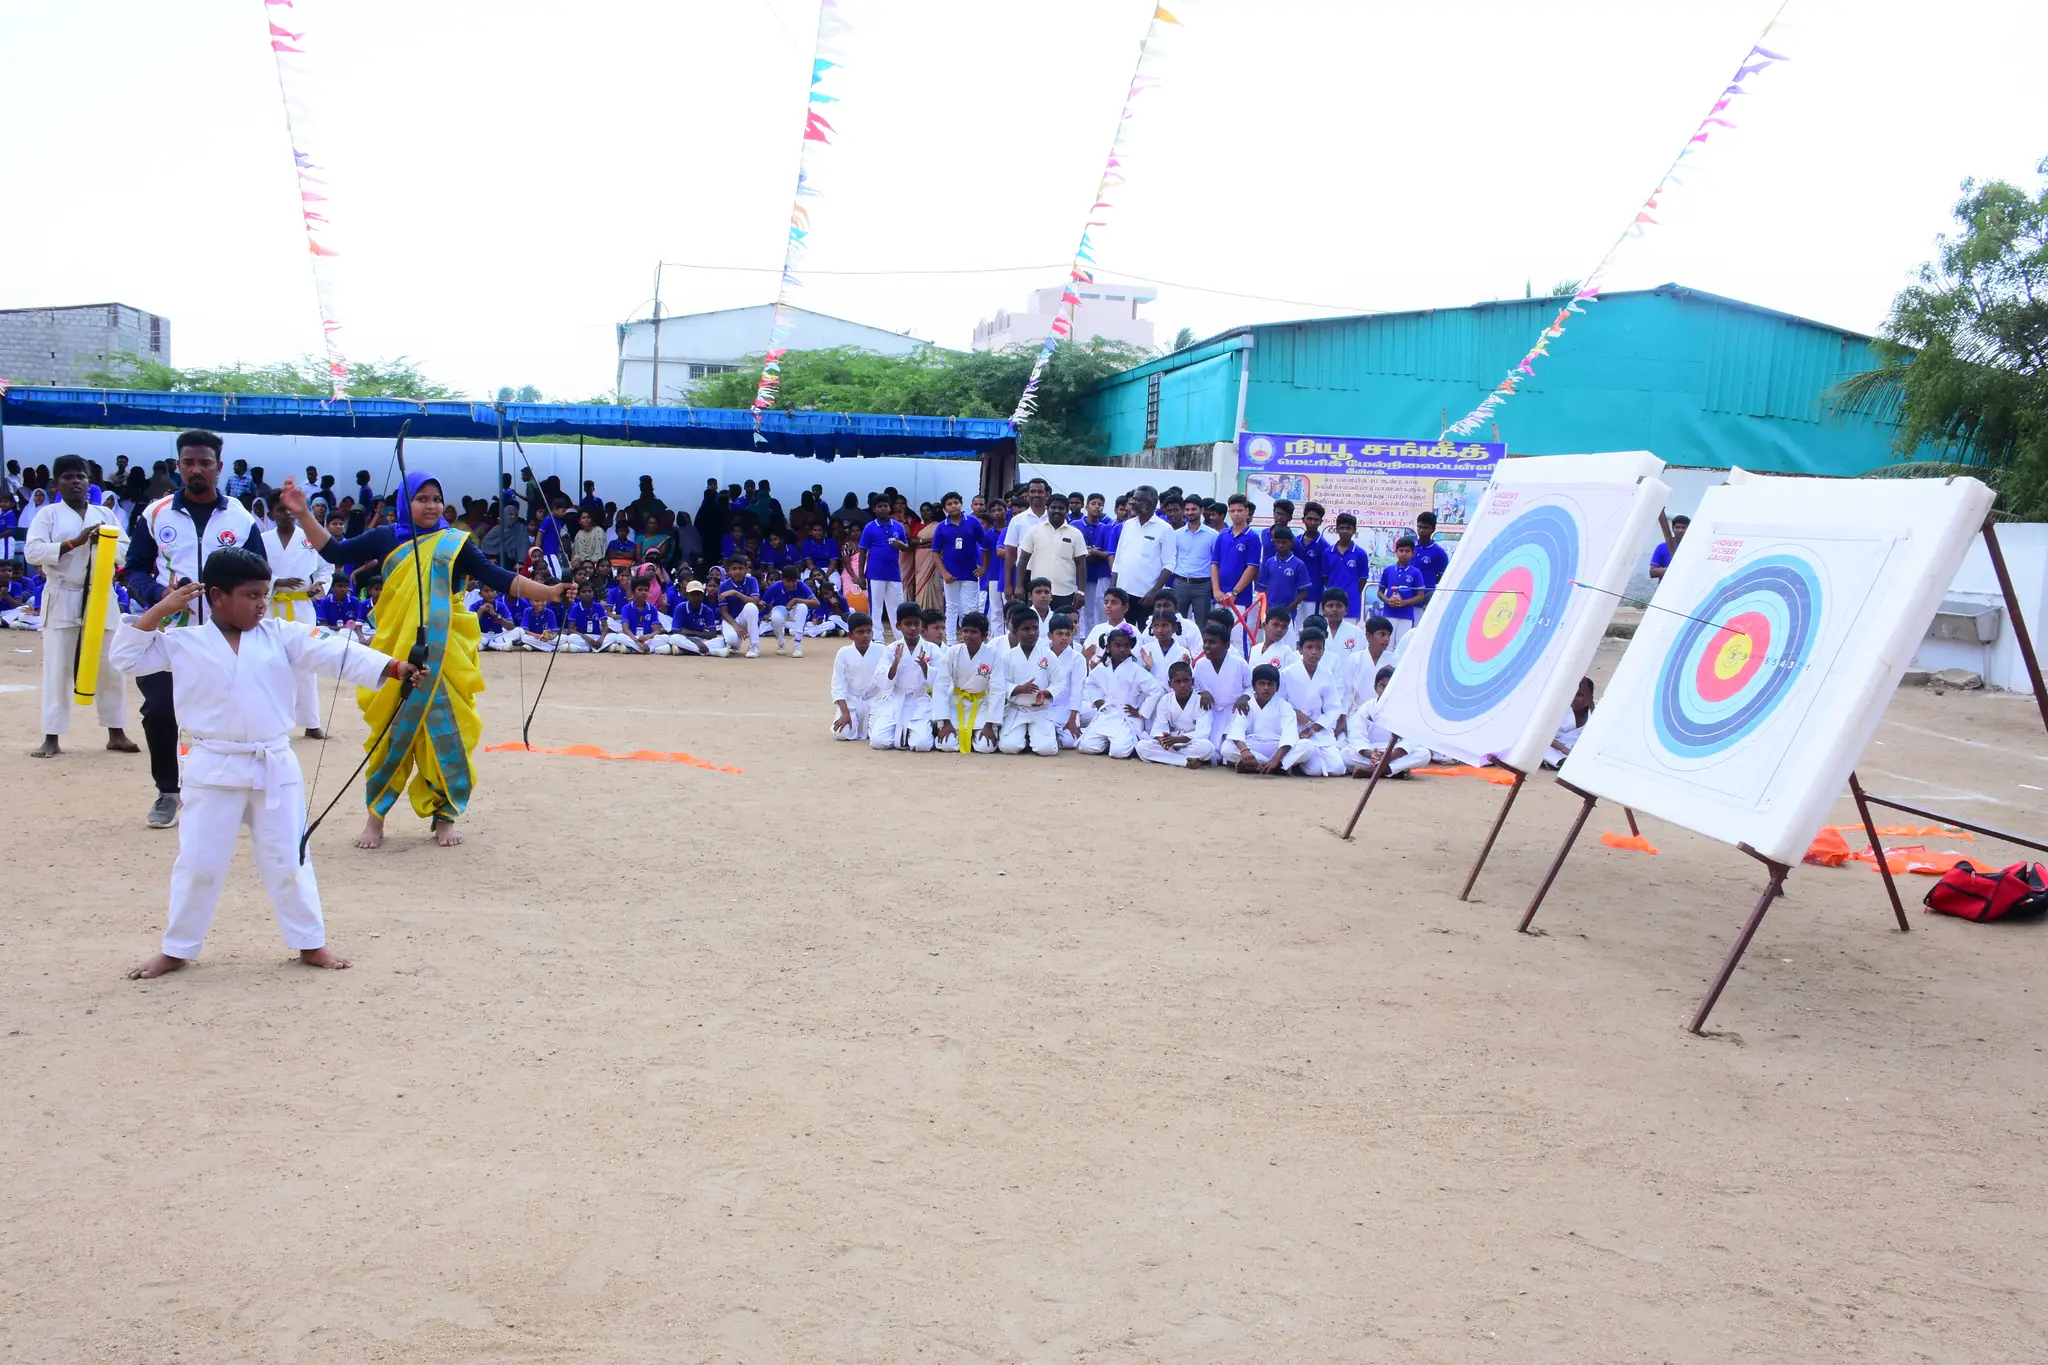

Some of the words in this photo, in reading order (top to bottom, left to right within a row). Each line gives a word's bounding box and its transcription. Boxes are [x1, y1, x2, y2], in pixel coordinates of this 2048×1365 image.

[1284, 439, 1353, 460] நியூ
[1361, 441, 1490, 463] சங்கீத்
[1277, 458, 1342, 467] மெட்ரிக்
[160, 543, 178, 551] INDIA
[1787, 661, 1795, 669] 3
